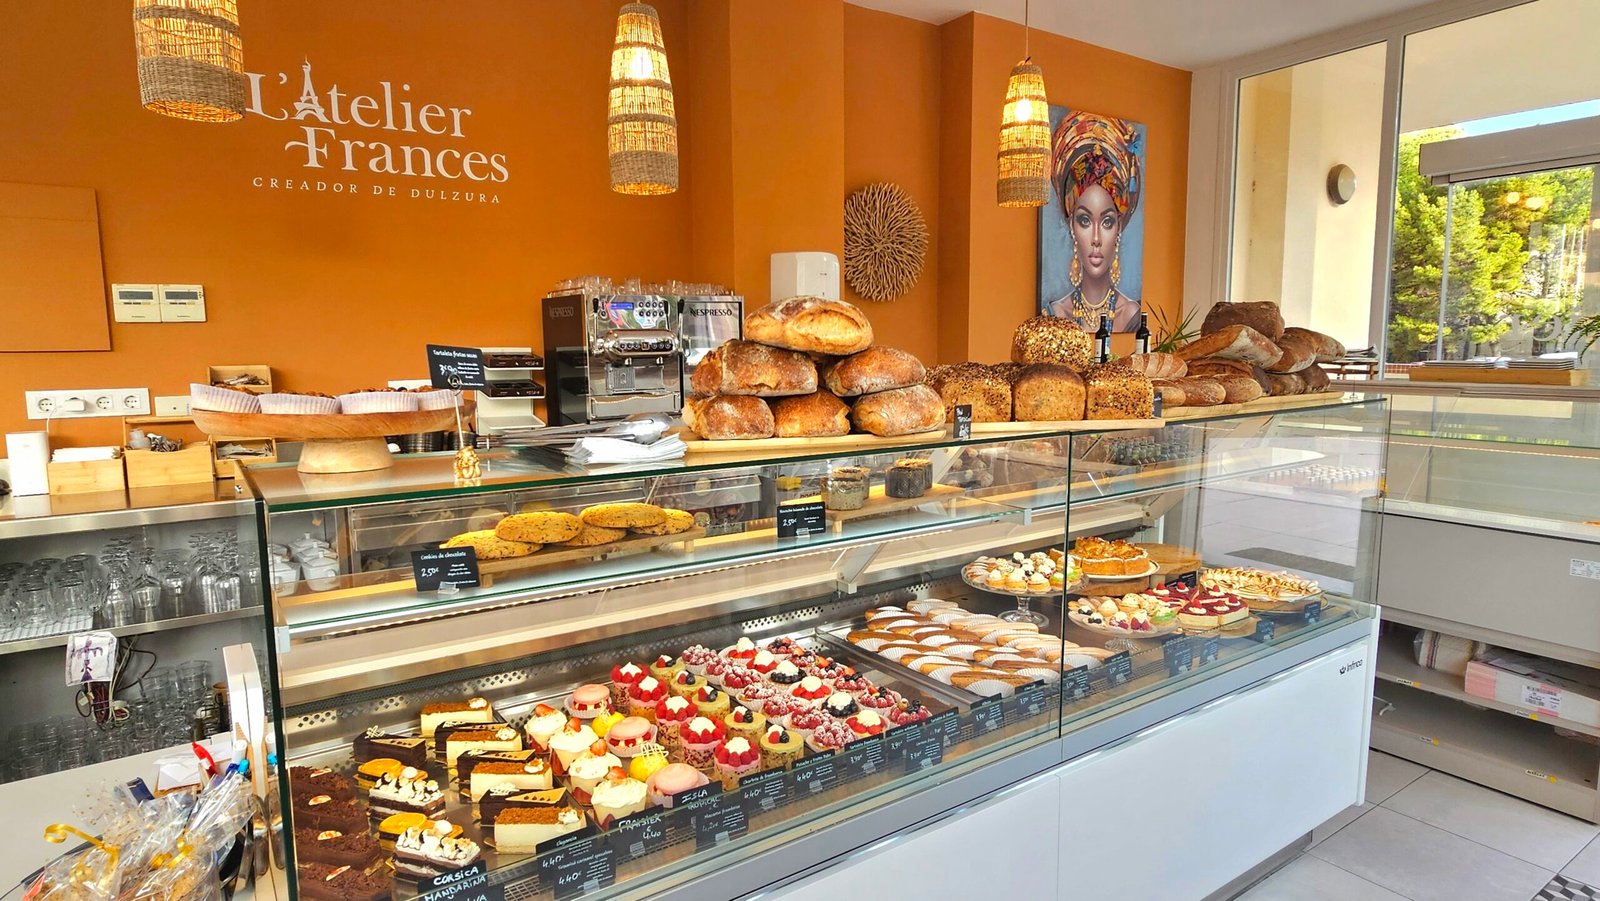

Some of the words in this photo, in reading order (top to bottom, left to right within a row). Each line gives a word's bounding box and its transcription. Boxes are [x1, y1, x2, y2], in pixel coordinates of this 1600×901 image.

[285, 126, 509, 183] Frances
[253, 177, 358, 194] CREADOR
[373, 185, 396, 197] DE
[411, 188, 500, 204] DULZURA
[690, 307, 733, 317] NESPRESSO
[421, 567, 439, 578] 2,50€
[682, 788, 708, 804] ISLA
[558, 871, 582, 885] 4,40€
